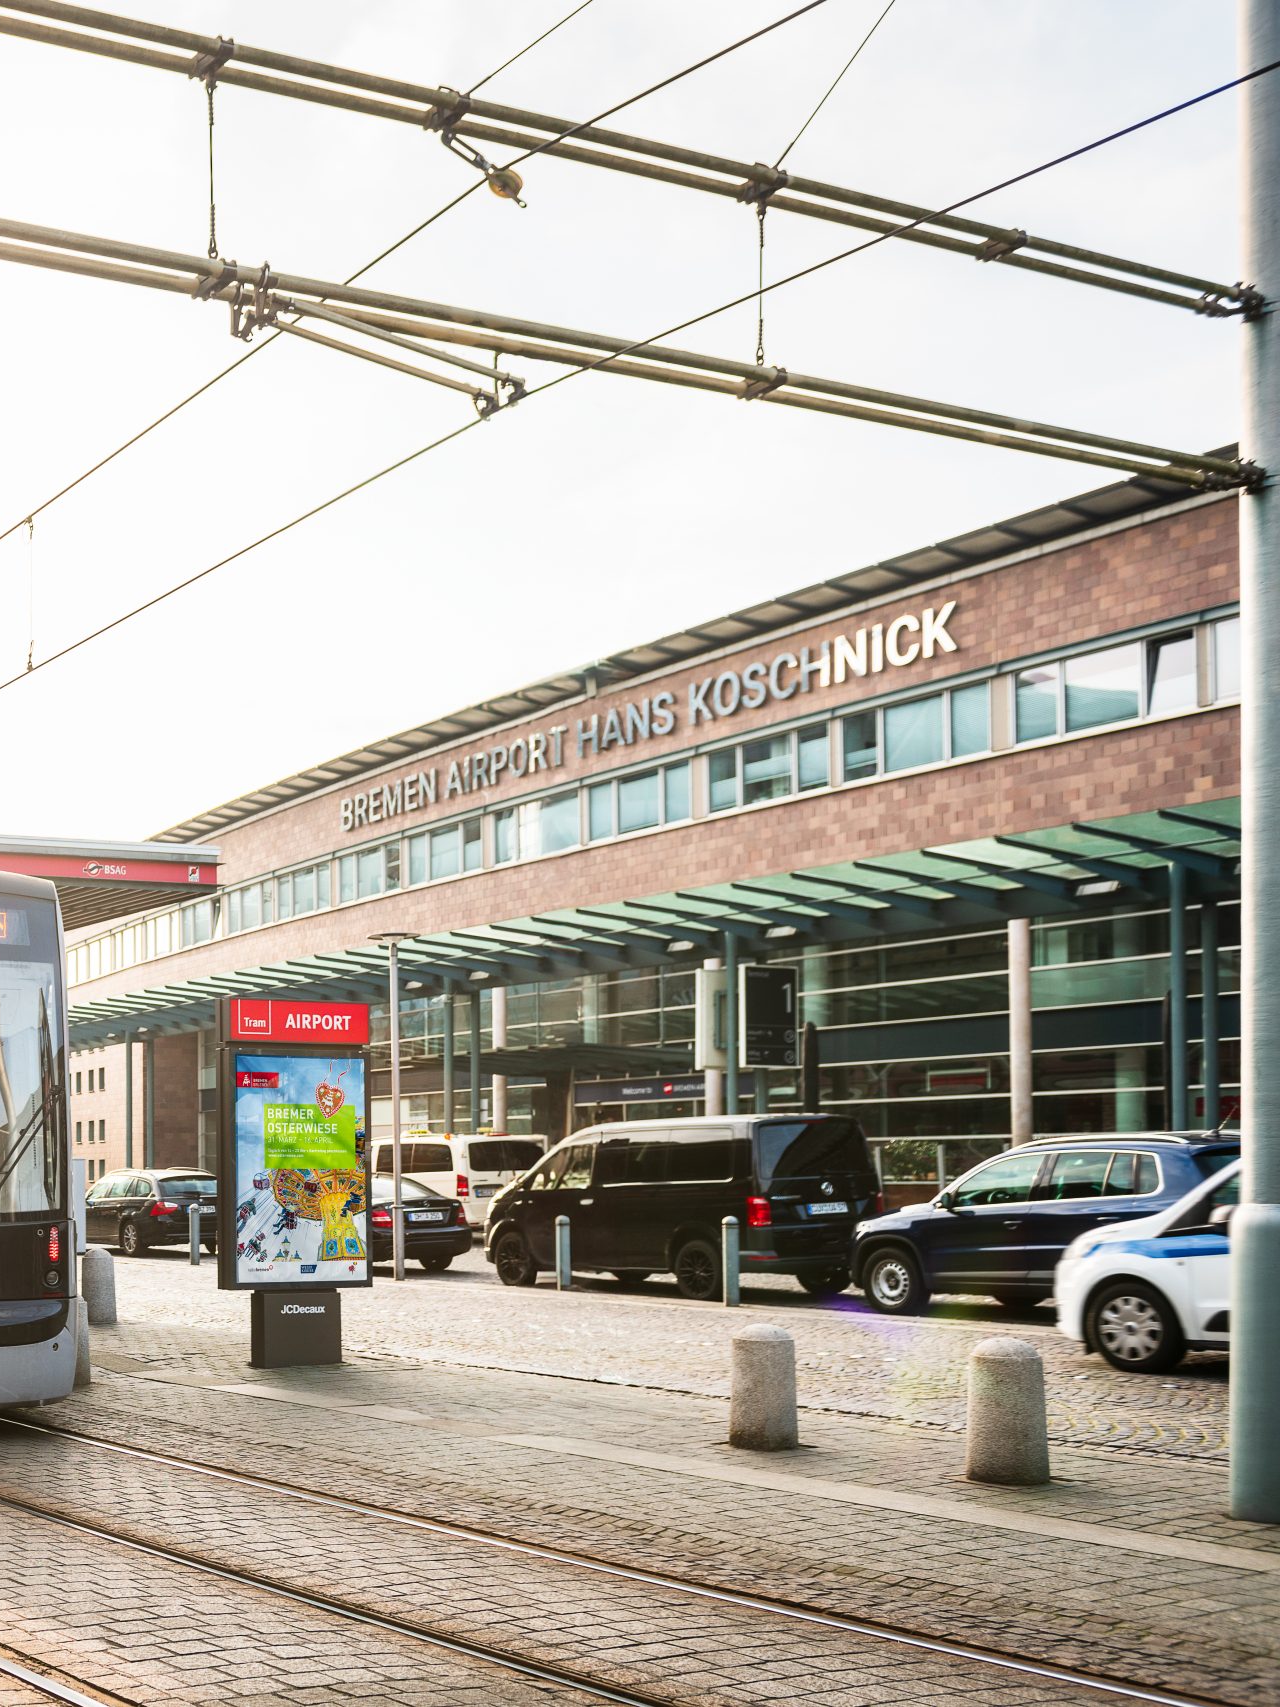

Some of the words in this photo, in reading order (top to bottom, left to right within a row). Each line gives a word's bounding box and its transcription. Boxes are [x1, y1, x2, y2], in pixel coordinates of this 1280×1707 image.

[339, 767, 438, 832] BREMEN
[443, 725, 568, 799] AIRPORT
[576, 690, 675, 759] HANS
[688, 600, 958, 726] KOSCHNICK
[104, 864, 127, 876] BSAG
[781, 982, 792, 1013] 1
[243, 1016, 266, 1028] Tram
[285, 1013, 352, 1031] AIRPORT
[267, 1108, 314, 1120] BREMER
[267, 1122, 338, 1135] OSTERWIESE
[280, 1304, 326, 1314] JCDecaux
